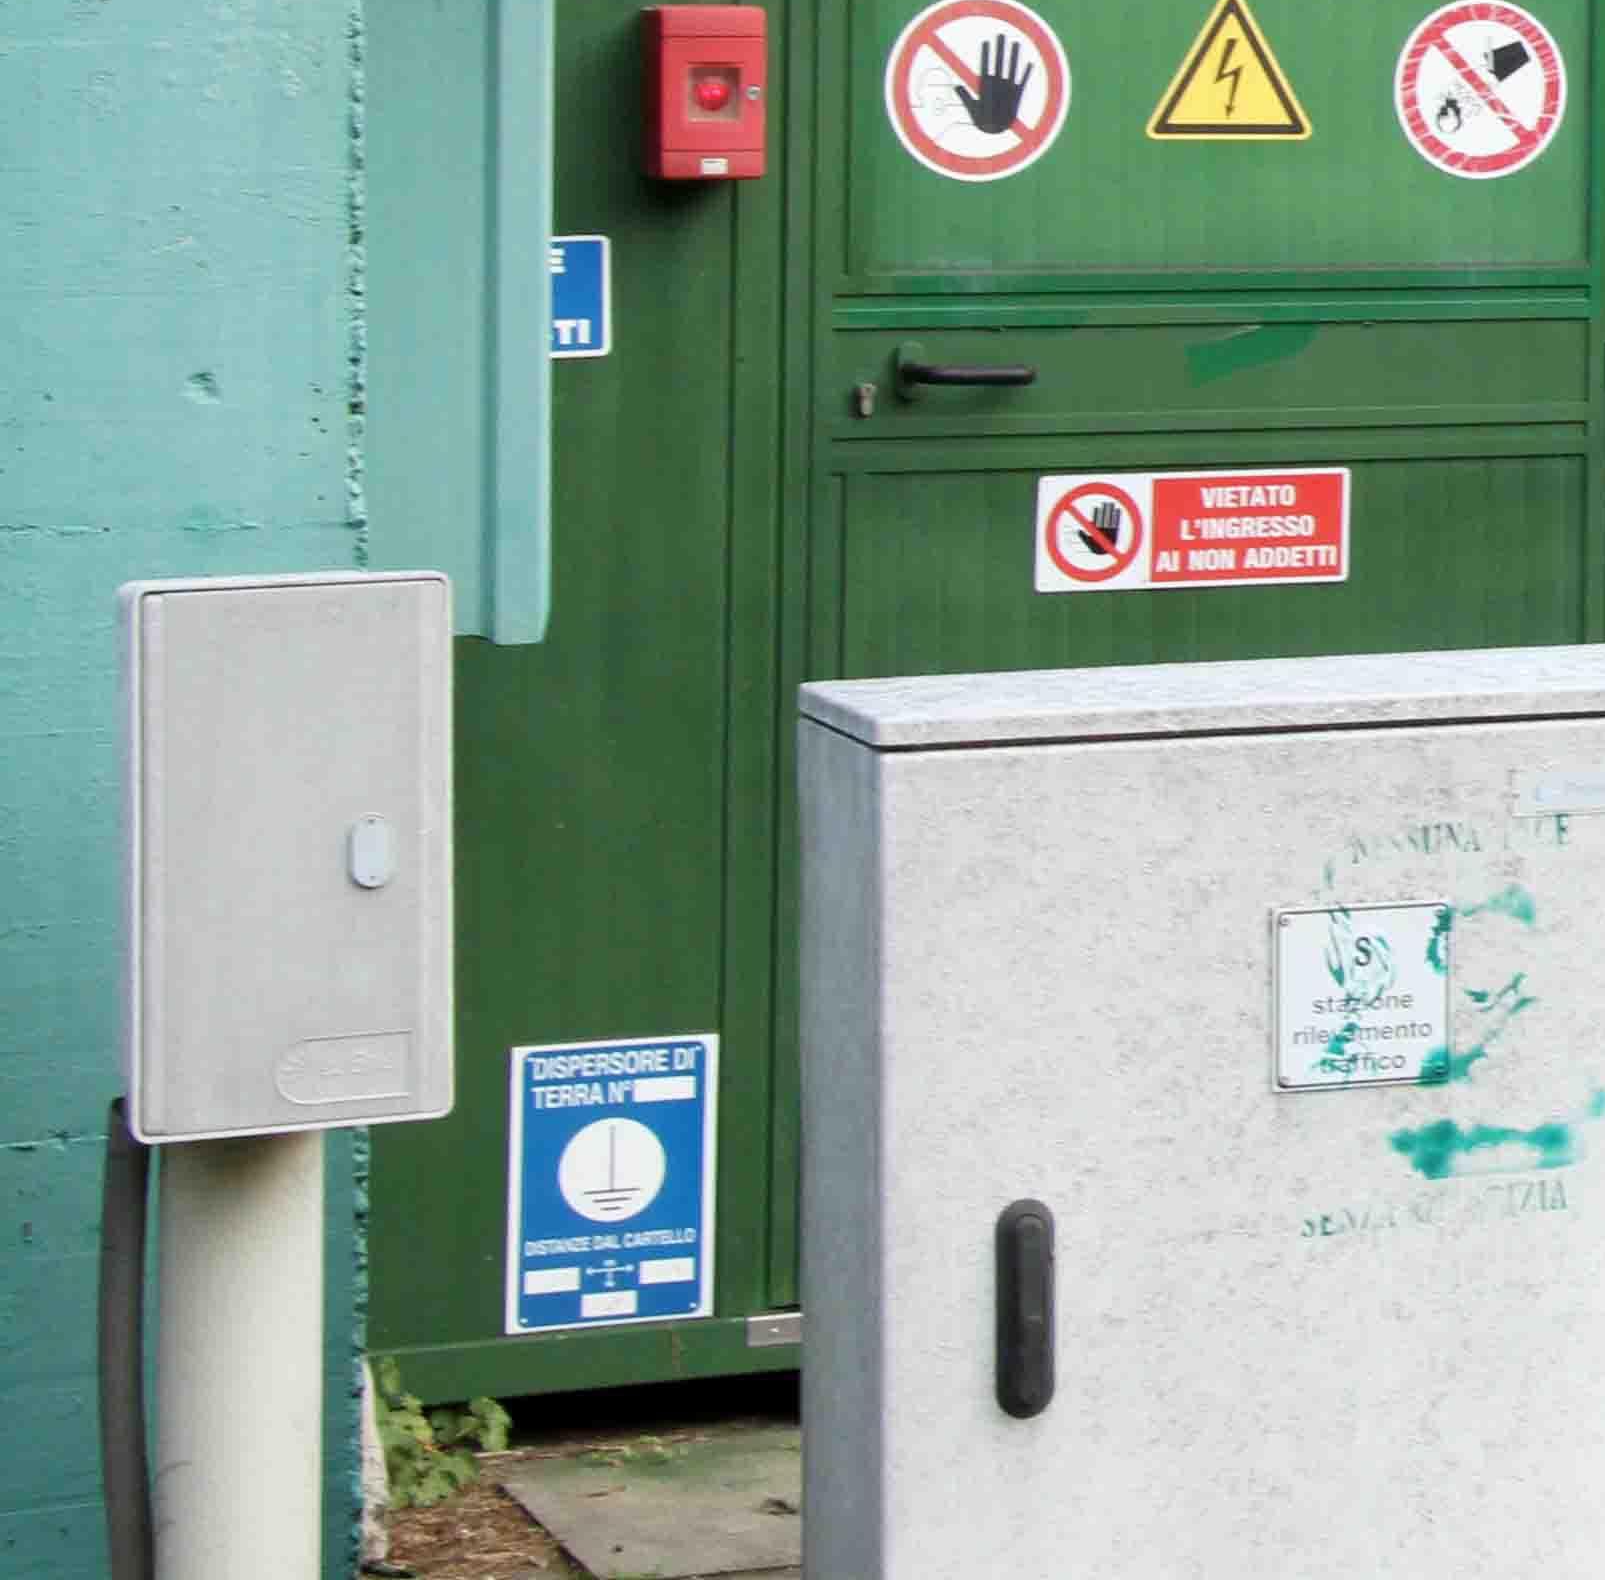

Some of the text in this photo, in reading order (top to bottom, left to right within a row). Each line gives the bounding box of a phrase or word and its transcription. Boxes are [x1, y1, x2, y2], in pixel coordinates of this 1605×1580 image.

[1201, 484, 1297, 508] VIETATO
[1180, 515, 1316, 541] L'INGRESSO
[1156, 545, 1338, 573] AI NON ADDETTI
[532, 1047, 697, 1081] DISPERSORE DI
[531, 1082, 606, 1109] TERRA
[525, 1227, 697, 1257] DISTANZE DAL CARTELLO
